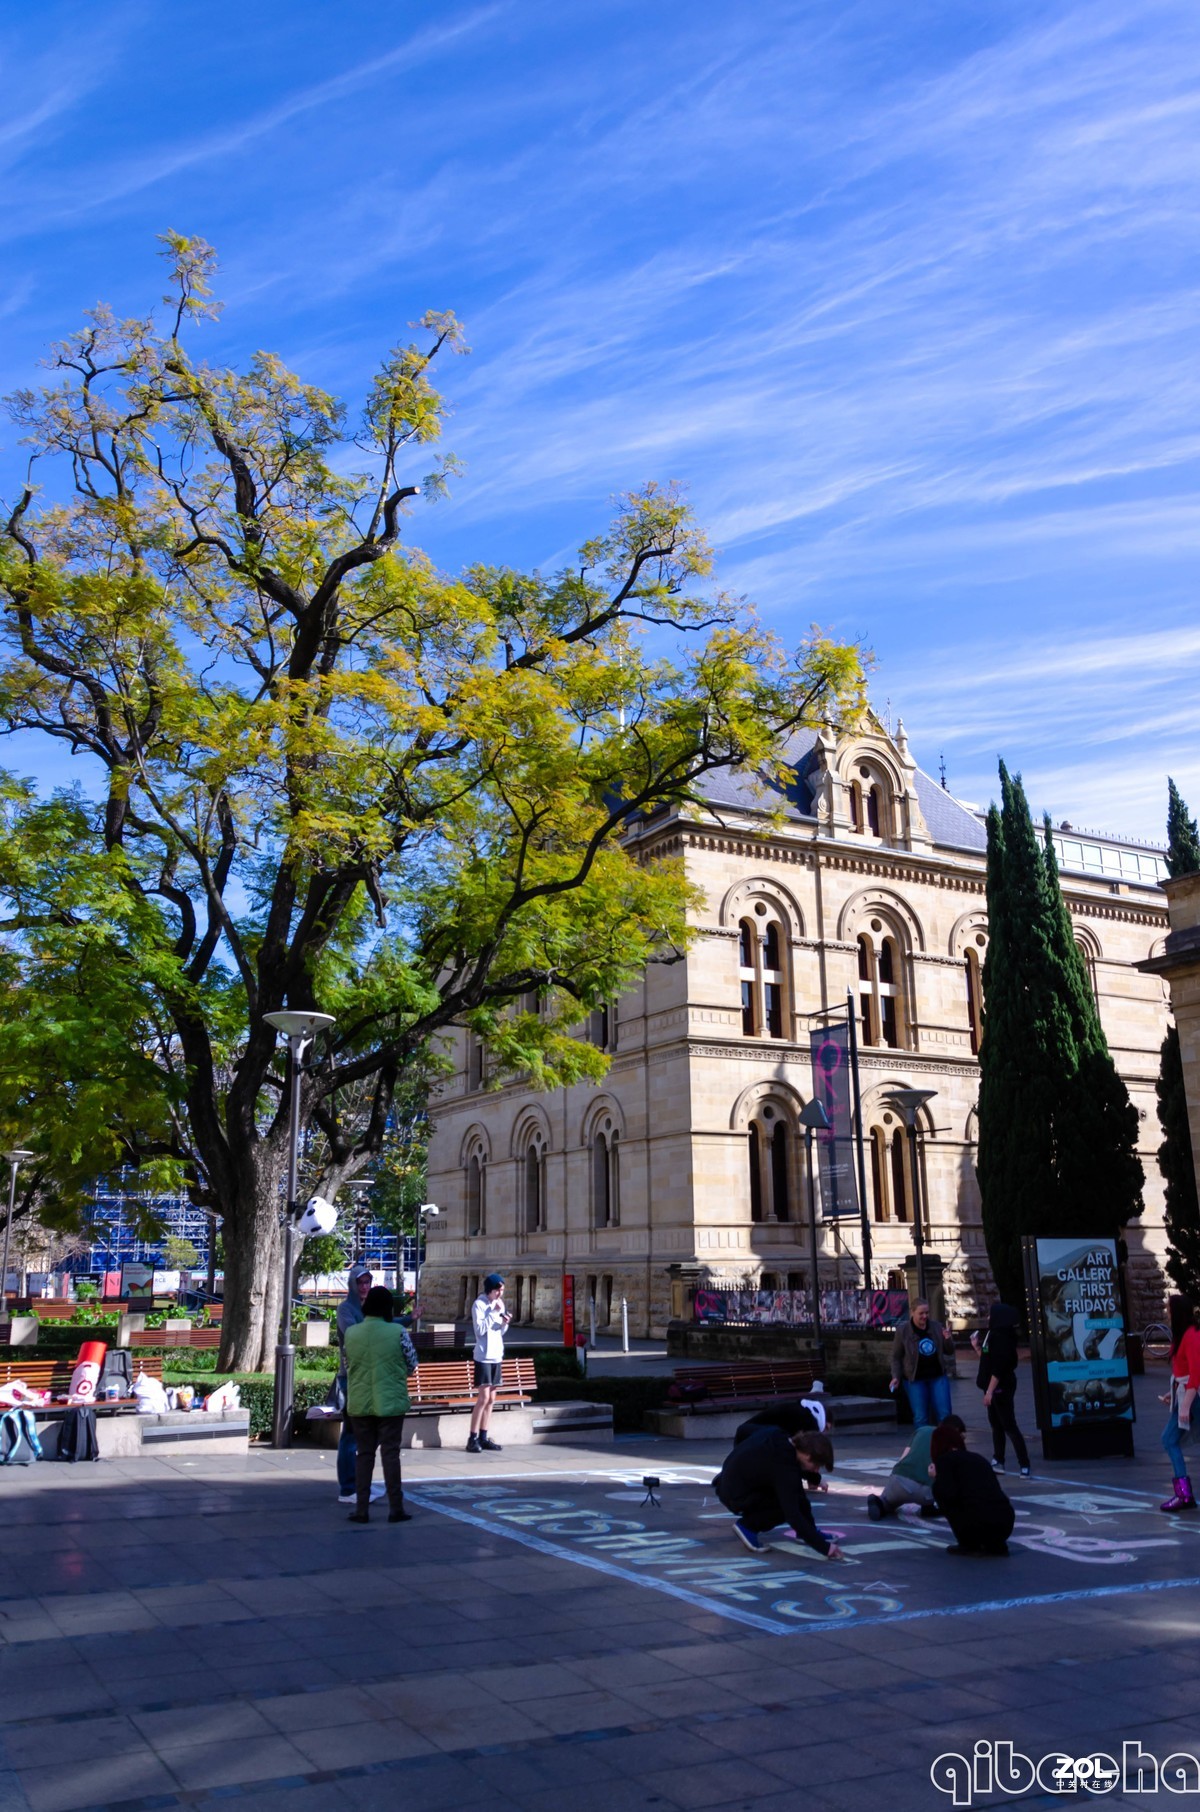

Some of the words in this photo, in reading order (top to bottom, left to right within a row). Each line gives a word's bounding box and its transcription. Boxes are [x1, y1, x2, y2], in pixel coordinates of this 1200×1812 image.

[1086, 1252, 1110, 1265] ART
[1057, 1267, 1111, 1281] GALLERY
[1080, 1282, 1113, 1296] FIRST
[1065, 1298, 1116, 1312] FRIDAYS
